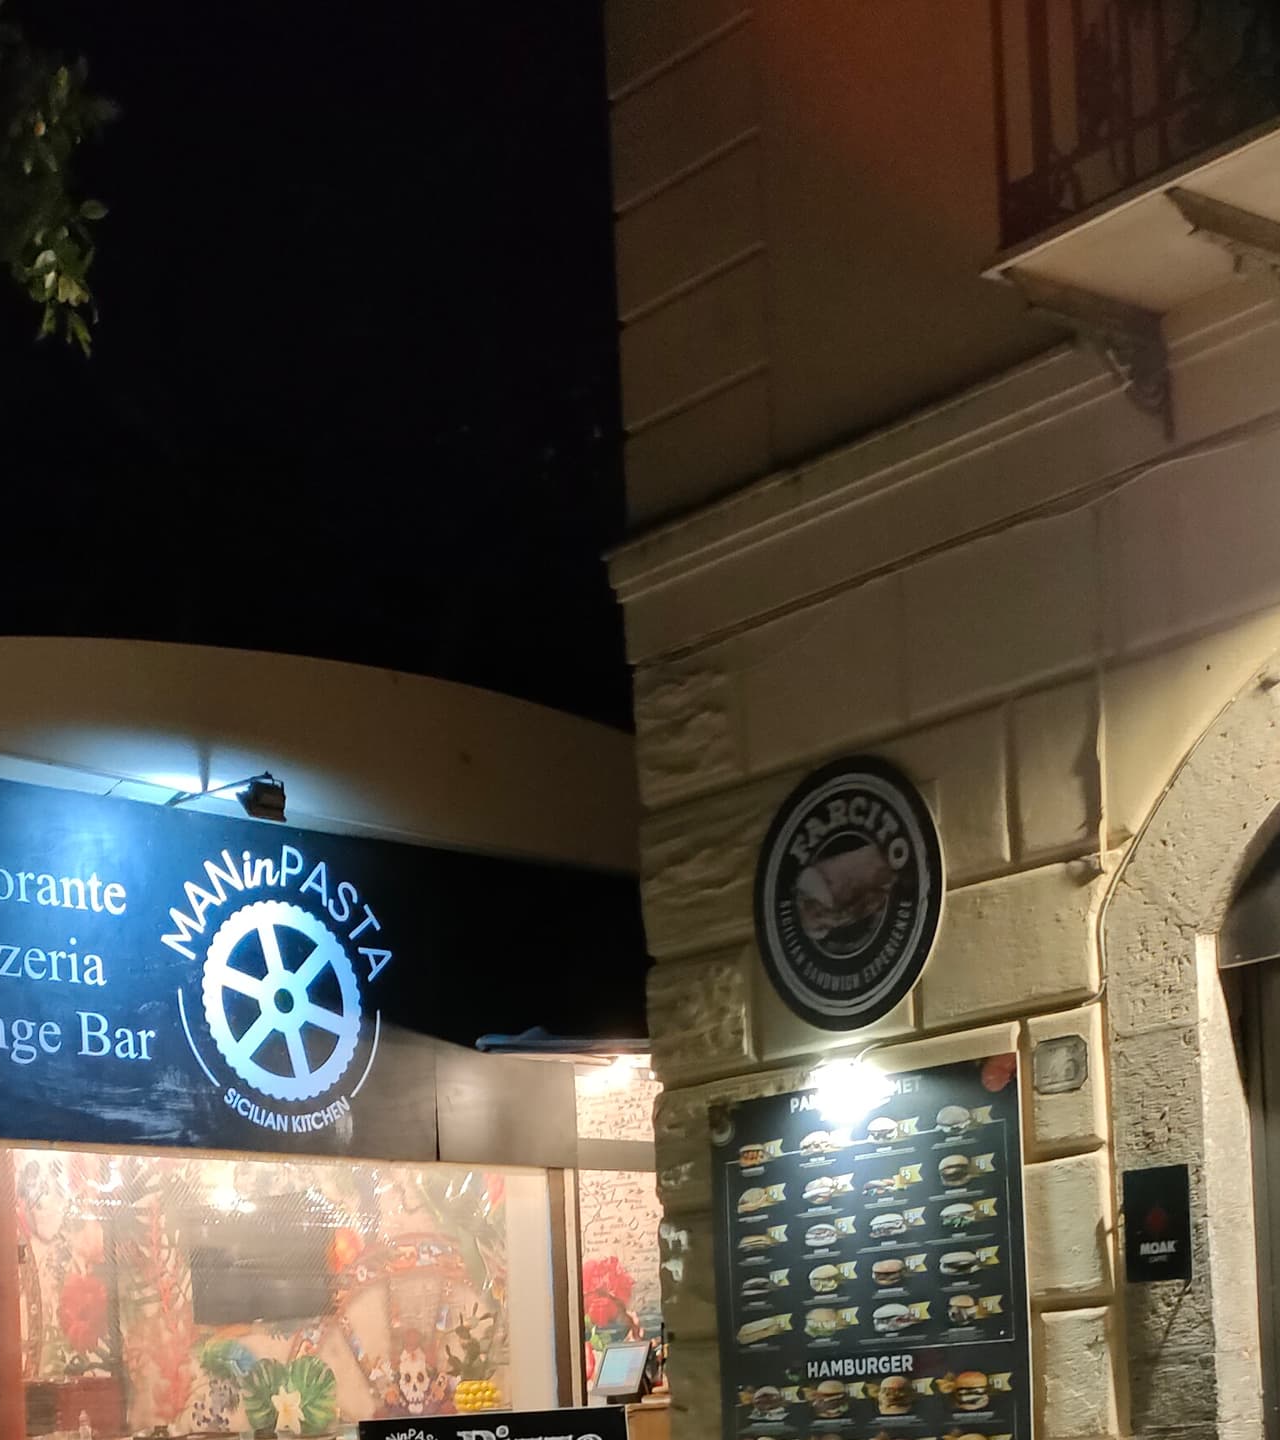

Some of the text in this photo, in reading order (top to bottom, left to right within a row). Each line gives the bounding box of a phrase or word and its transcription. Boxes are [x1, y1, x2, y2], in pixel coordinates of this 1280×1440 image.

[160, 845, 392, 983] MANinPASTA
[78, 1012, 156, 1061] Bar
[223, 1087, 350, 1133] SICILIAN KITCHEN
[807, 1354, 913, 1378] HAMBURGER
